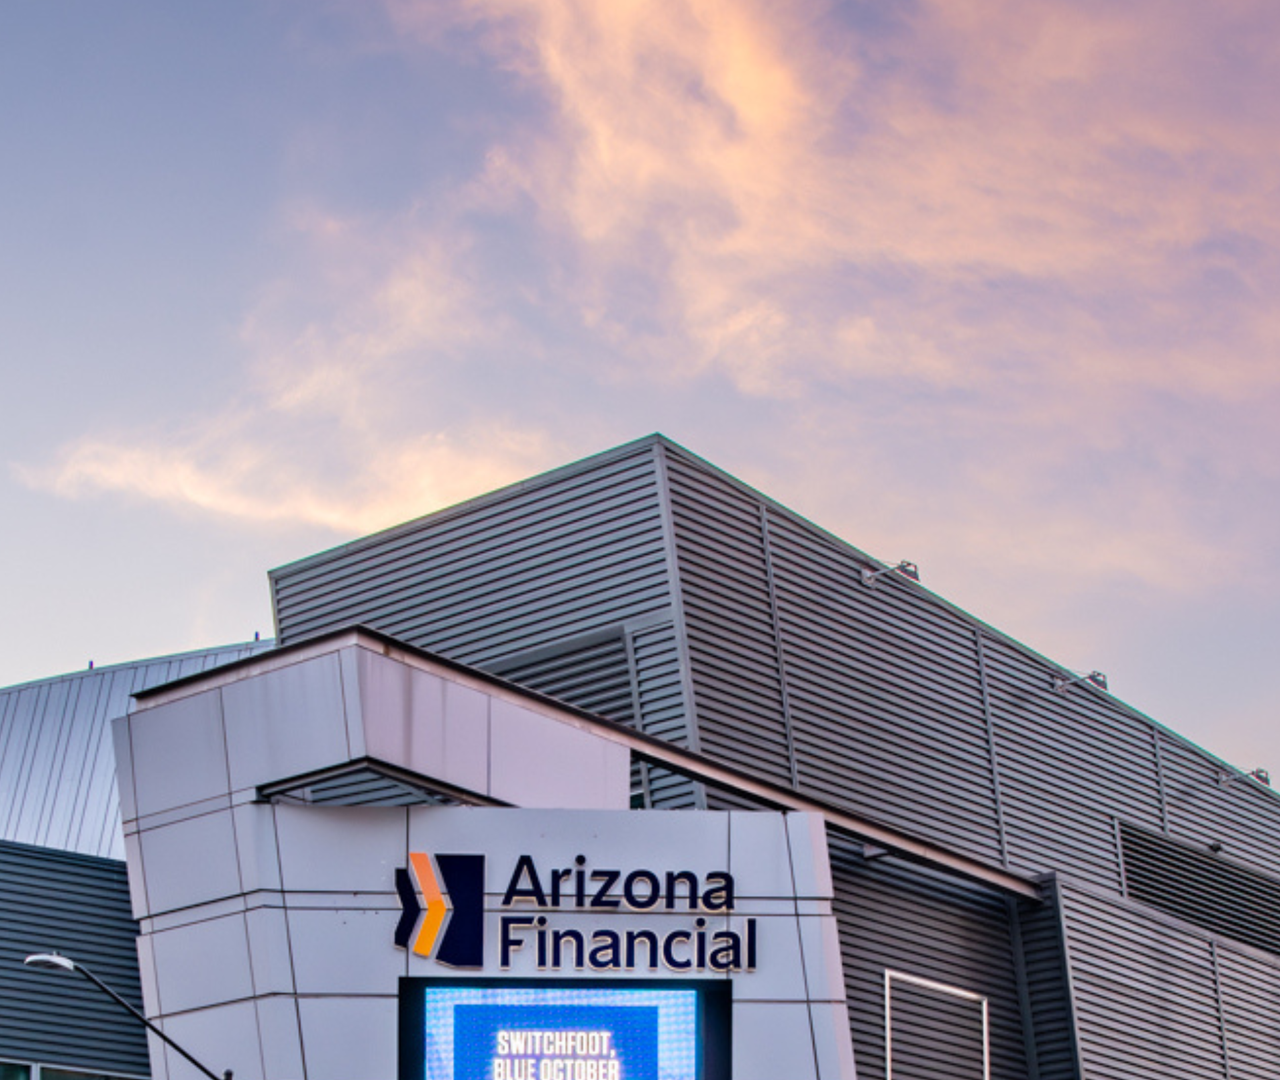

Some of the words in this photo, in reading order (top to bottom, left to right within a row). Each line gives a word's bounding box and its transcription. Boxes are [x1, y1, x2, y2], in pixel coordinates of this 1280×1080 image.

[501, 854, 735, 911] Arizona
[499, 915, 757, 973] Financial
[496, 1030, 616, 1058] SWITCHFOOT,
